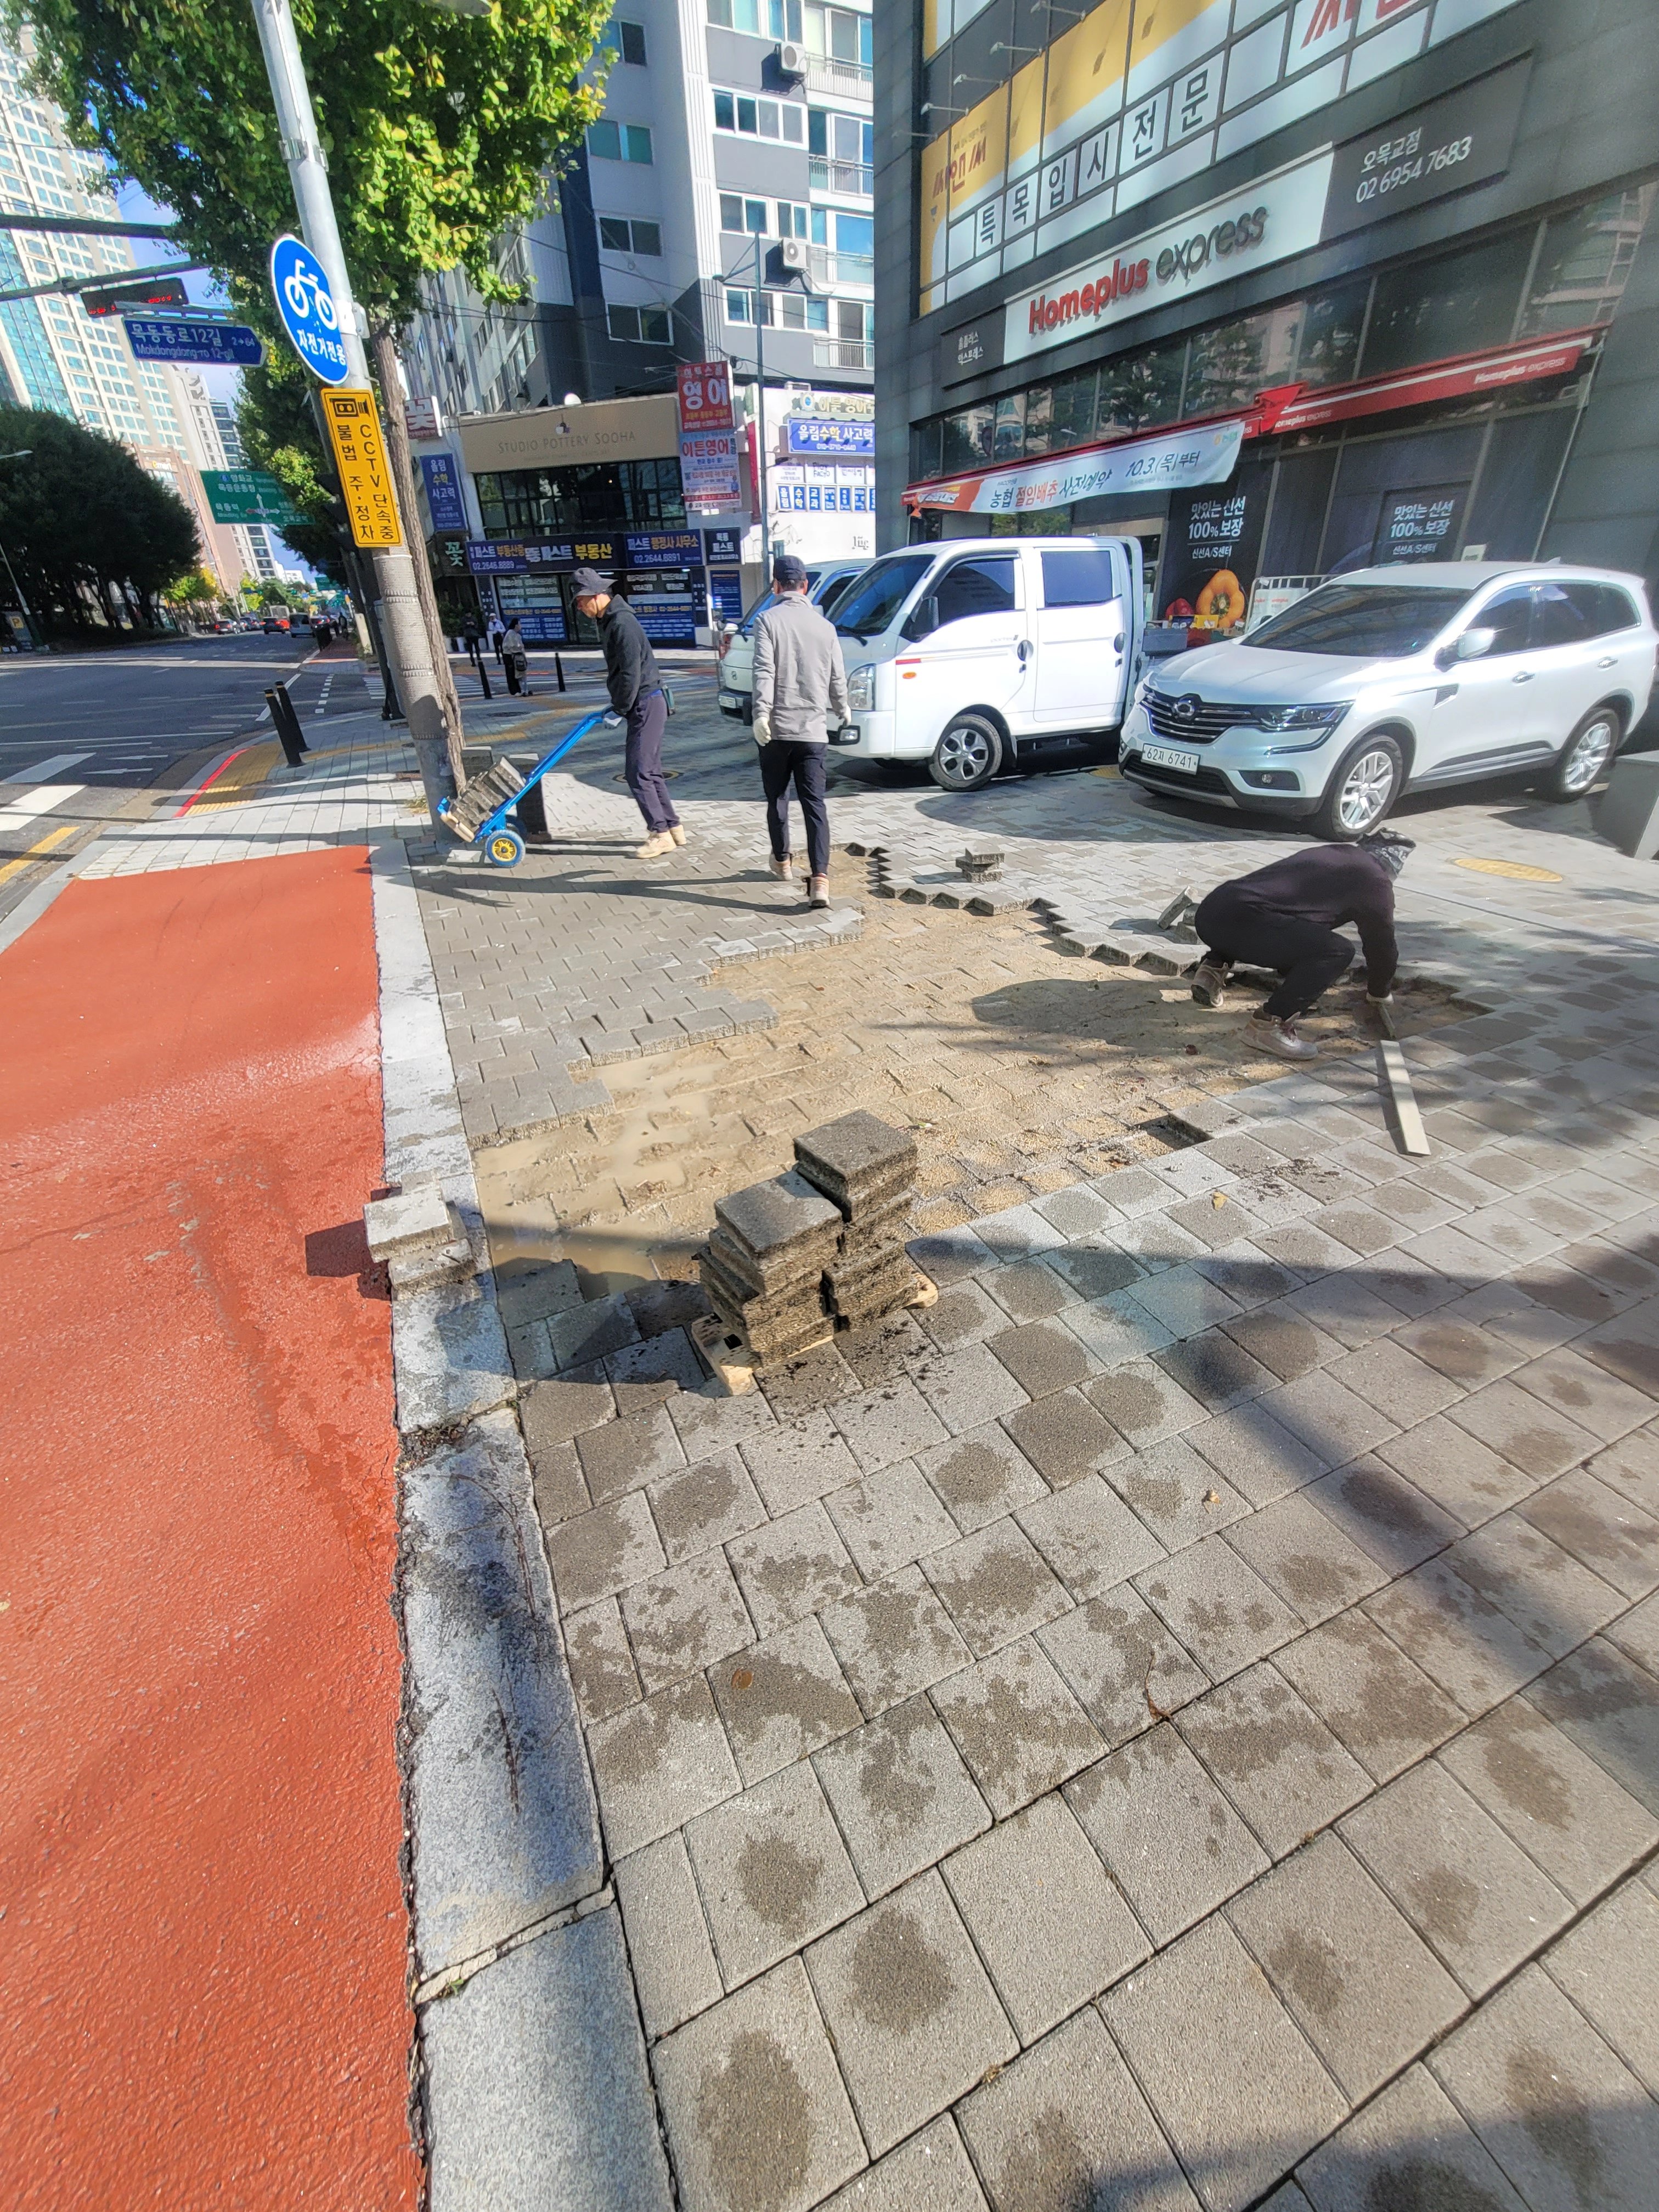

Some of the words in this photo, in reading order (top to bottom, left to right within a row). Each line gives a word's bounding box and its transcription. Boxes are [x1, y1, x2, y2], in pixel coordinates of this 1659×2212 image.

[1361, 127, 1422, 173] 오목교점
[1356, 176, 1378, 203] 02
[1379, 156, 1423, 193] 6954
[1425, 136, 1472, 176] 7683
[1028, 258, 1150, 334] Homeplus
[1155, 206, 1268, 281] express
[132, 324, 223, 347] 목동동로12길
[958, 331, 979, 350] 홈플러스
[296, 329, 347, 366] 자전거전용
[957, 346, 984, 366] 익스프레스
[1474, 365, 1526, 384] Homeplus
[1527, 358, 1566, 373] express
[682, 378, 728, 410] 영어
[337, 425, 358, 462] 불법
[498, 440, 539, 454] STUDIO
[543, 433, 589, 449] POTTERY
[594, 431, 637, 445] SOOHA
[682, 438, 729, 457] 이튼영어
[431, 459, 446, 472] 올림
[359, 424, 380, 488] CCTV
[373, 494, 394, 540] 단속중
[432, 473, 448, 486] 수학
[990, 487, 1014, 509] 농협
[1015, 479, 1058, 507] 절임배추
[1059, 468, 1113, 499] 사전예약
[432, 487, 456, 500] 사고력
[1190, 500, 1222, 521] 맛있는
[1223, 495, 1246, 517] 신선
[1393, 503, 1427, 522] 맛있는
[1429, 500, 1454, 518] 신선
[1188, 521, 1219, 539] 100%
[1219, 517, 1244, 537] 보장
[1390, 522, 1423, 538] 100%
[1423, 518, 1451, 536] 보장
[444, 541, 465, 567] 꽃
[575, 543, 614, 560] 부동산
[1192, 545, 1233, 560] 신선A/S센터
[1167, 752, 1192, 769] 6741
